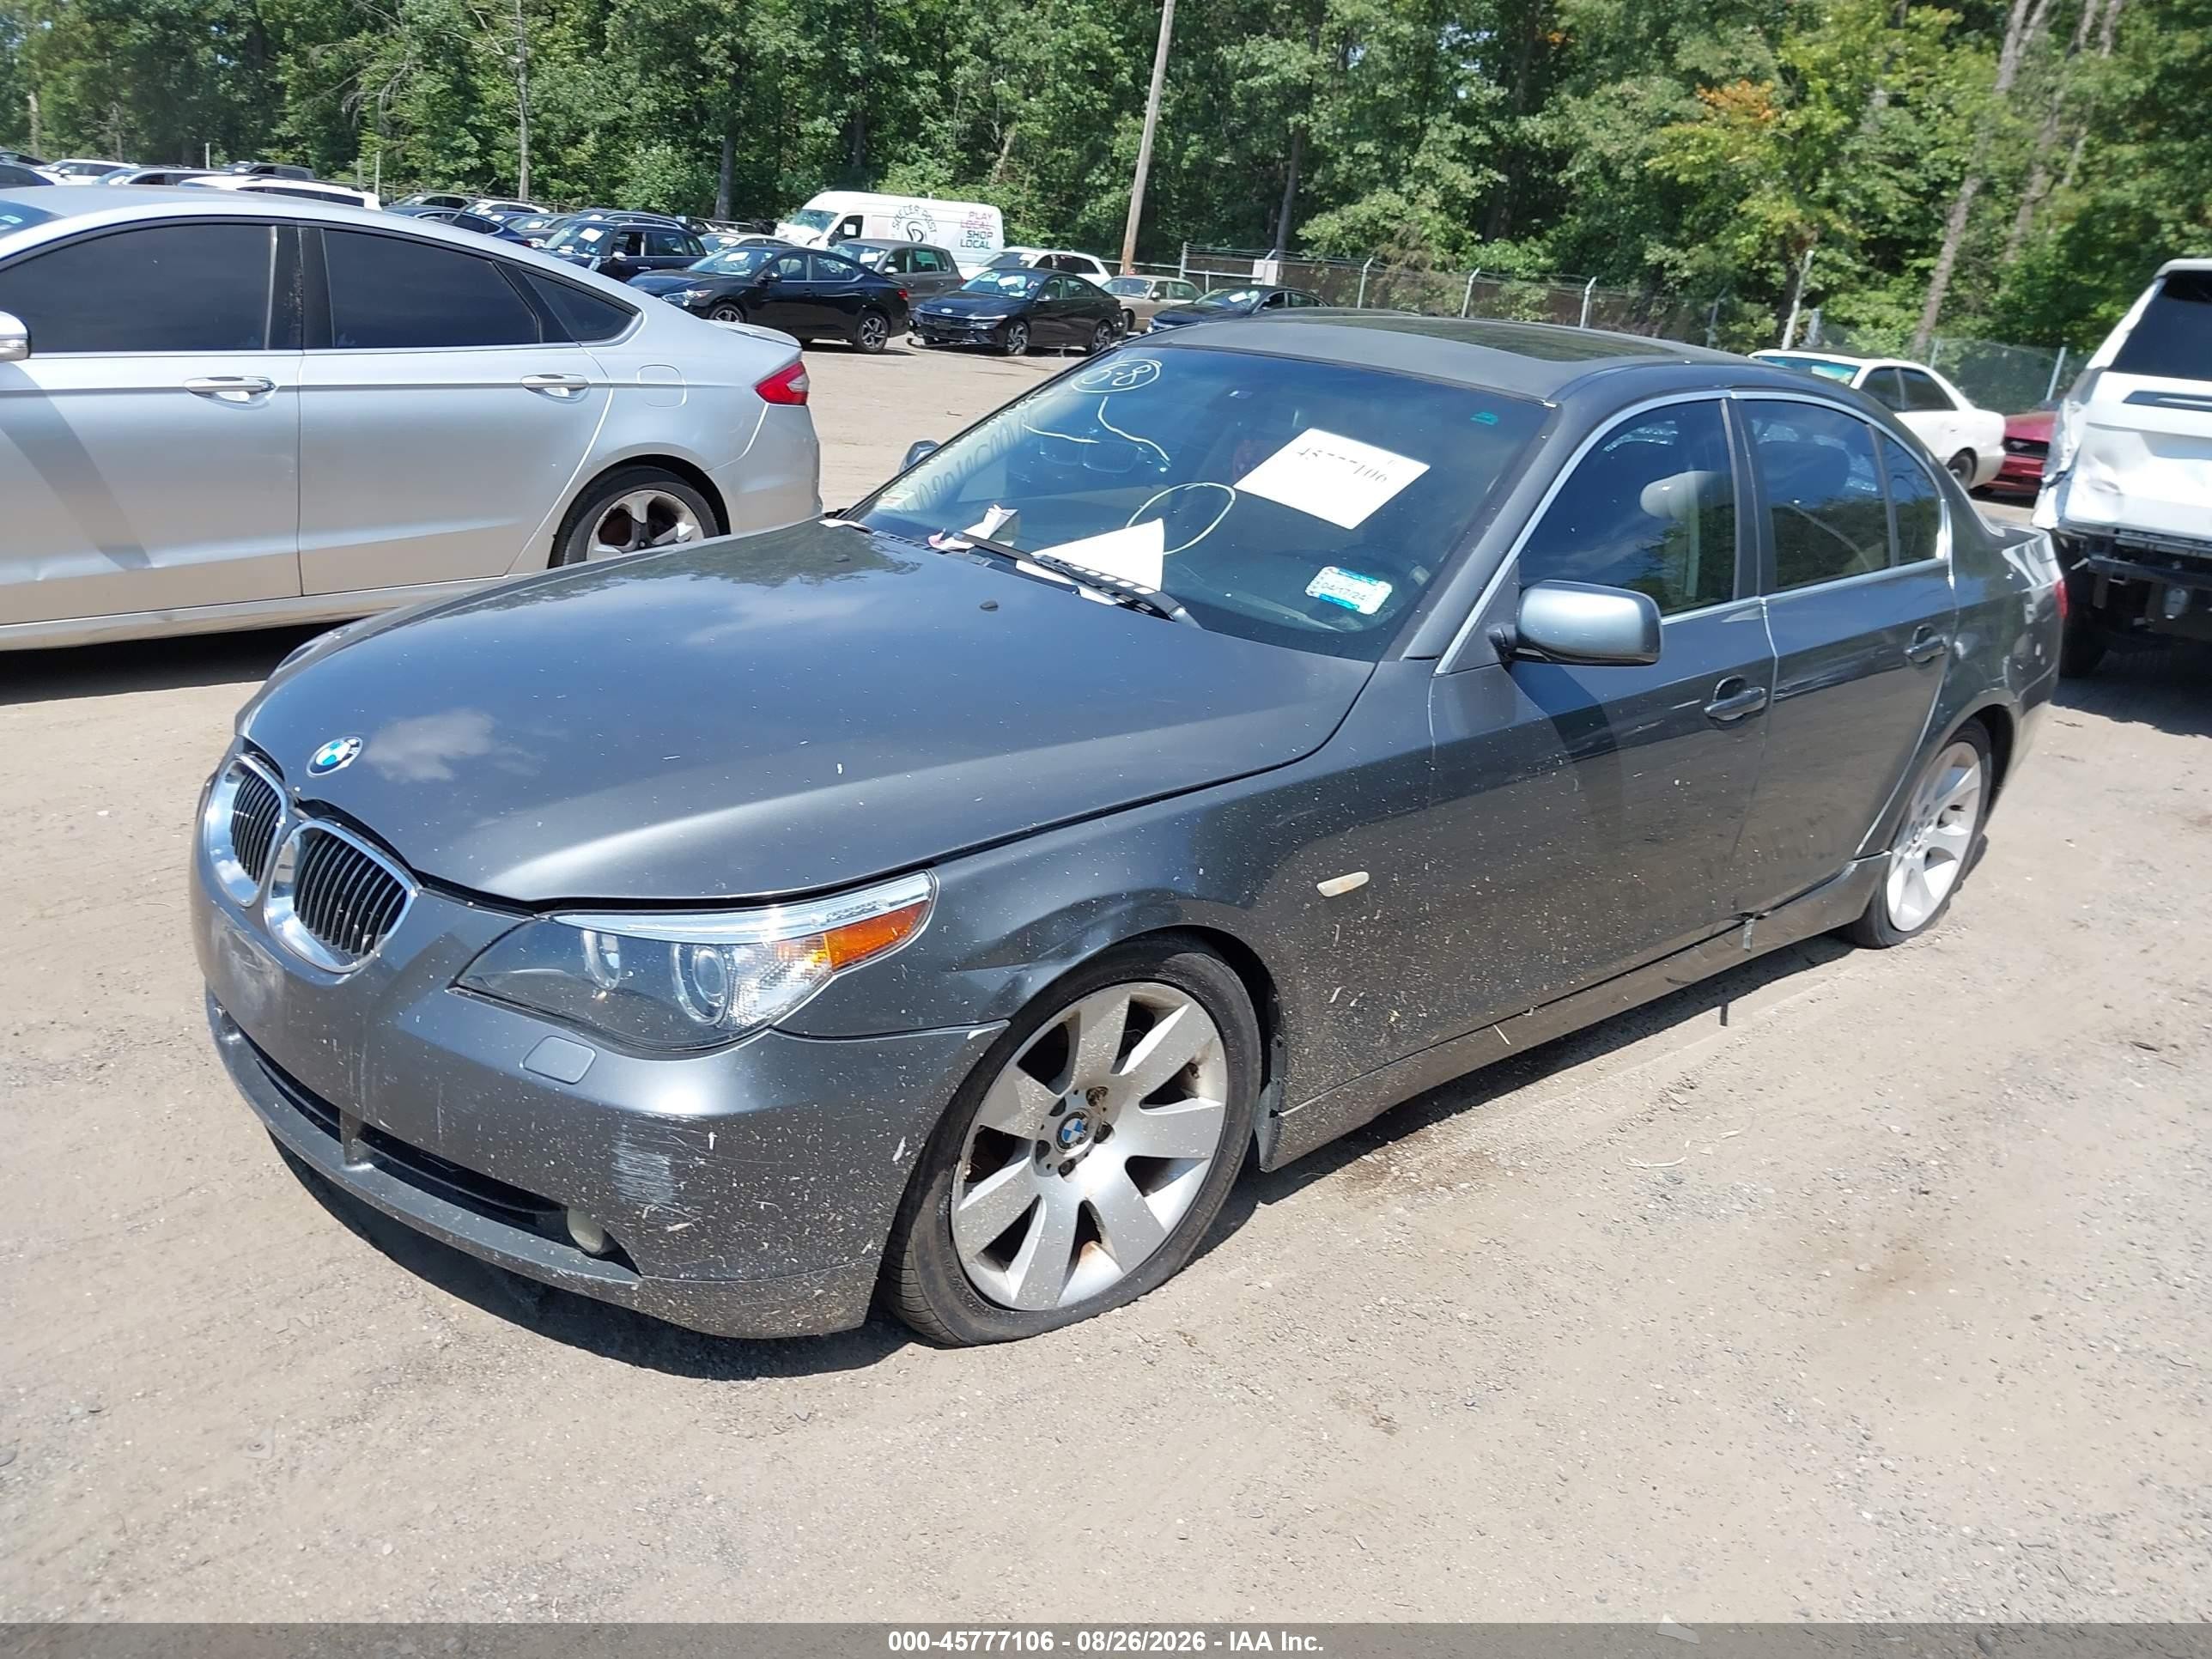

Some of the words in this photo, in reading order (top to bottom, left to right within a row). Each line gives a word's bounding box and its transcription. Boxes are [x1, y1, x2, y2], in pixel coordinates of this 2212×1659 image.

[968, 210, 994, 220] PLAY
[960, 220, 991, 231] LOCAL
[966, 229, 994, 240] SHOP
[959, 239, 992, 250] LOCAL
